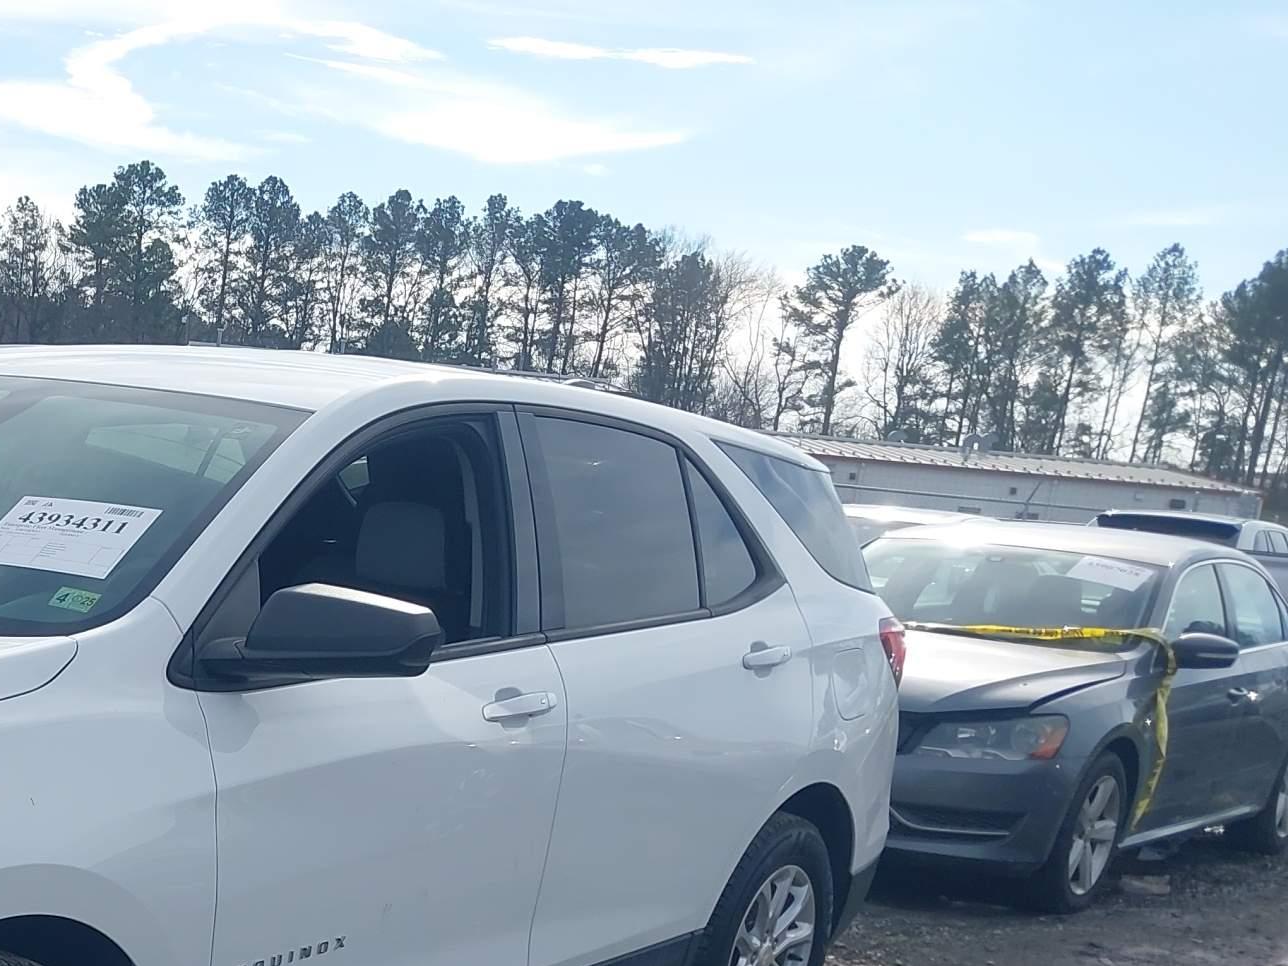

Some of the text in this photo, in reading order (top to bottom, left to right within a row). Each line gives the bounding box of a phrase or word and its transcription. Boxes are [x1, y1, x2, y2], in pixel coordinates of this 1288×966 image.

[18, 511, 129, 534] 43934311
[56, 593, 97, 607] 4 25
